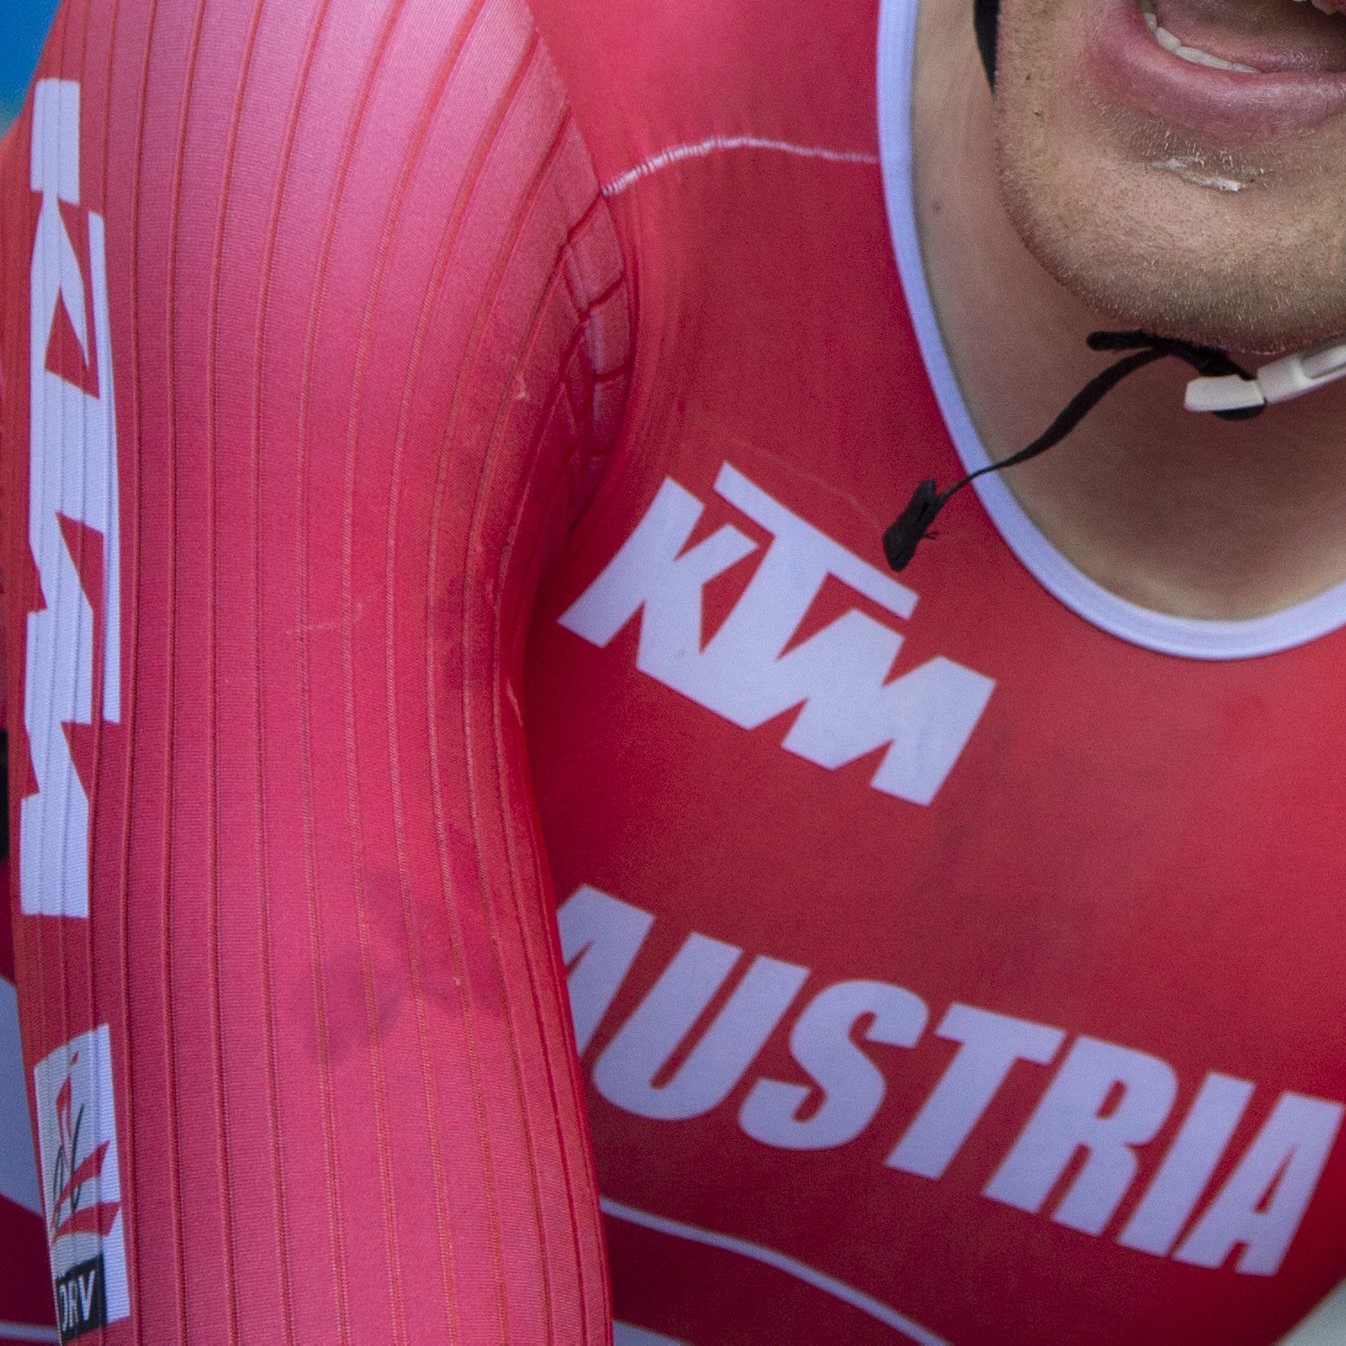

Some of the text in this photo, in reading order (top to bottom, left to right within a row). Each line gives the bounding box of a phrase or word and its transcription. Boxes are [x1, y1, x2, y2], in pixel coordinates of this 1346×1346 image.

[20, 78, 121, 918] KTM
[557, 460, 997, 807] KTM
[557, 884, 1345, 1276] AUSTRIA
